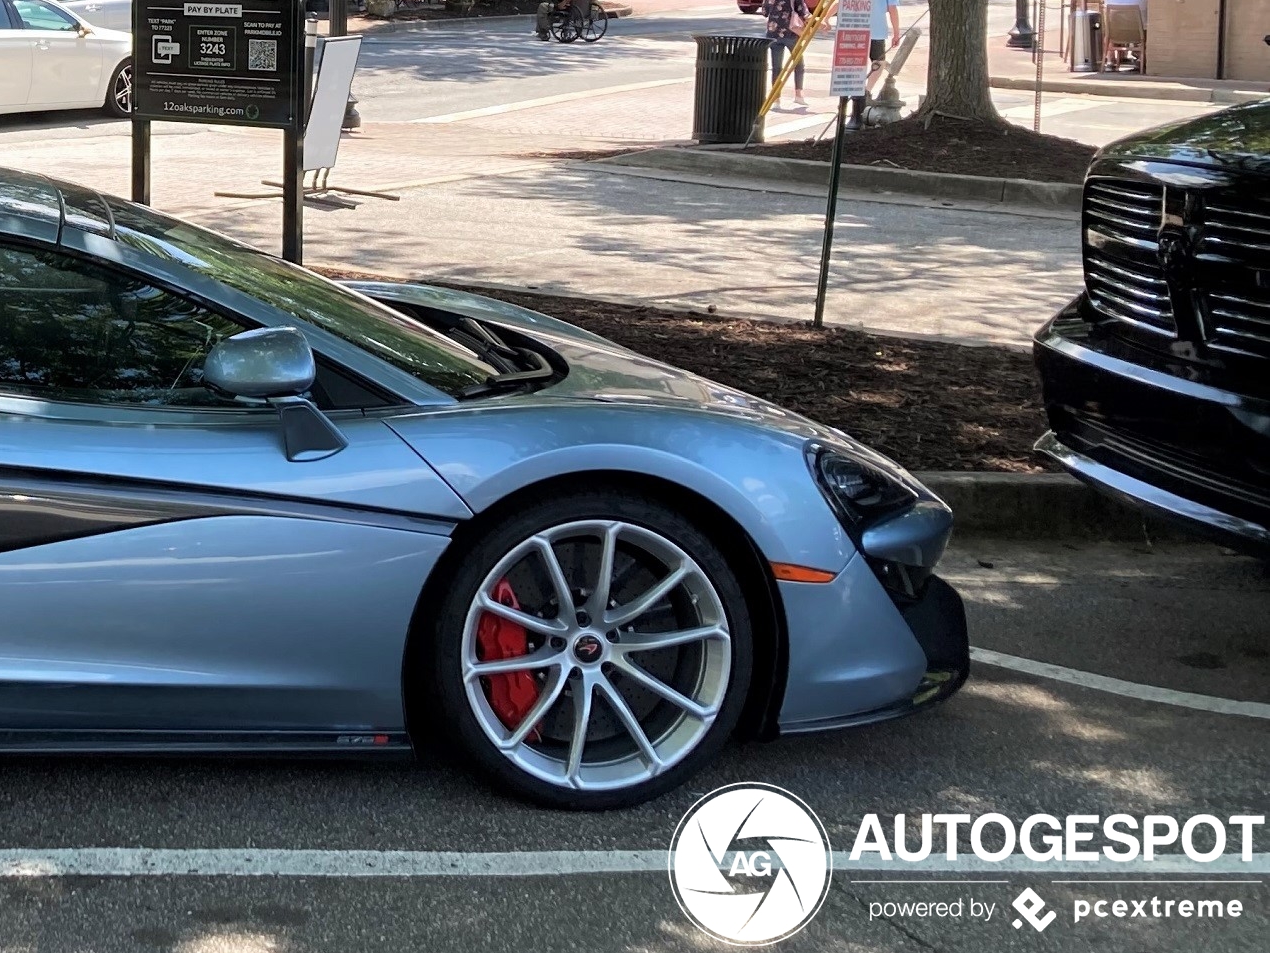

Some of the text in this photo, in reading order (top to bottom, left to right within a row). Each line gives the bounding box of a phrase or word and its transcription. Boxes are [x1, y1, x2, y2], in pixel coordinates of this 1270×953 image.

[187, 6, 238, 15] PAY BY PLATE
[842, 0, 871, 12] PARKING
[199, 43, 226, 55] 3243
[163, 101, 244, 116] 12oaksparking.com
